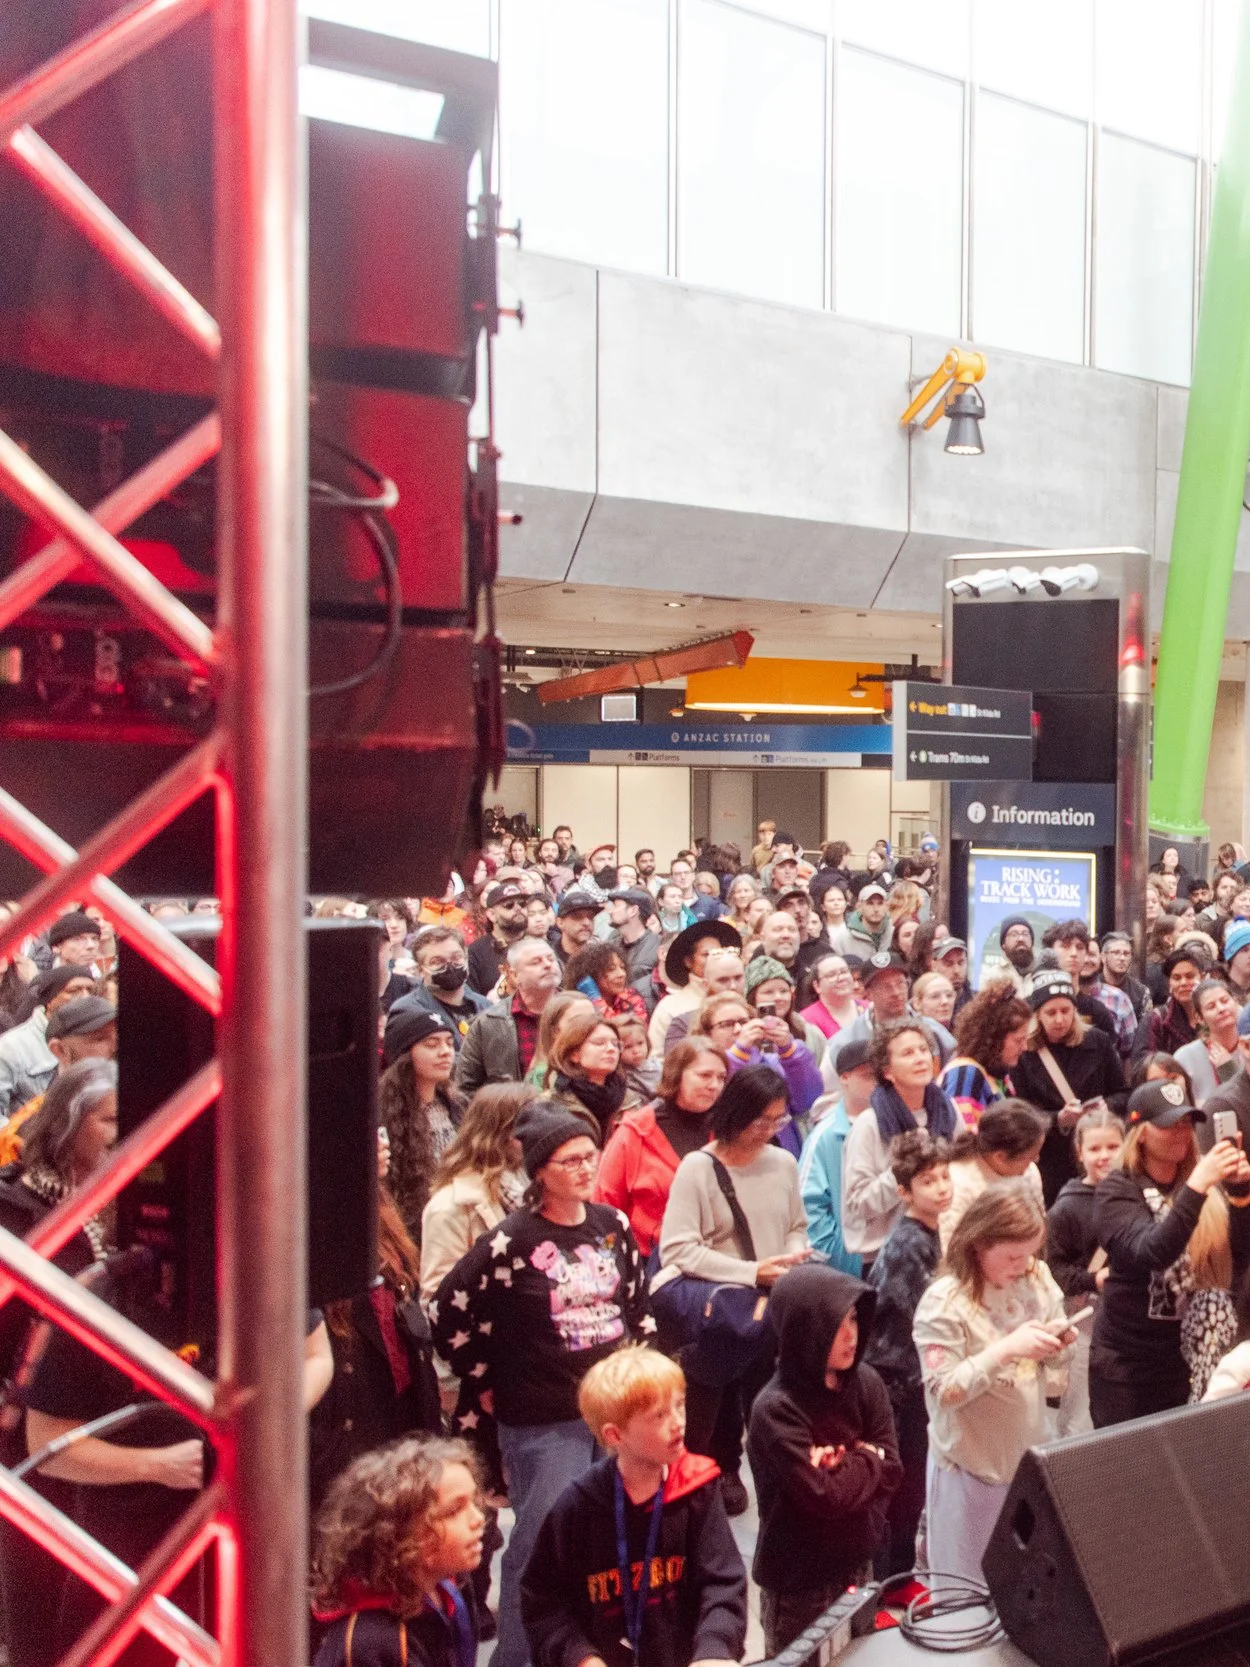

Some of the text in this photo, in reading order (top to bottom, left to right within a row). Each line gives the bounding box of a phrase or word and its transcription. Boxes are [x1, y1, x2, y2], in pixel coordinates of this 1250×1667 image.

[918, 702, 948, 716] Way out
[683, 733, 771, 744] ANZAC STATION
[650, 752, 681, 762] Platforms
[775, 753, 809, 764] Platforms
[928, 751, 949, 763] Trams
[992, 805, 1095, 826] Information
[980, 880, 1080, 900] TRACK WORK
[587, 1556, 686, 1604] FITZRO
